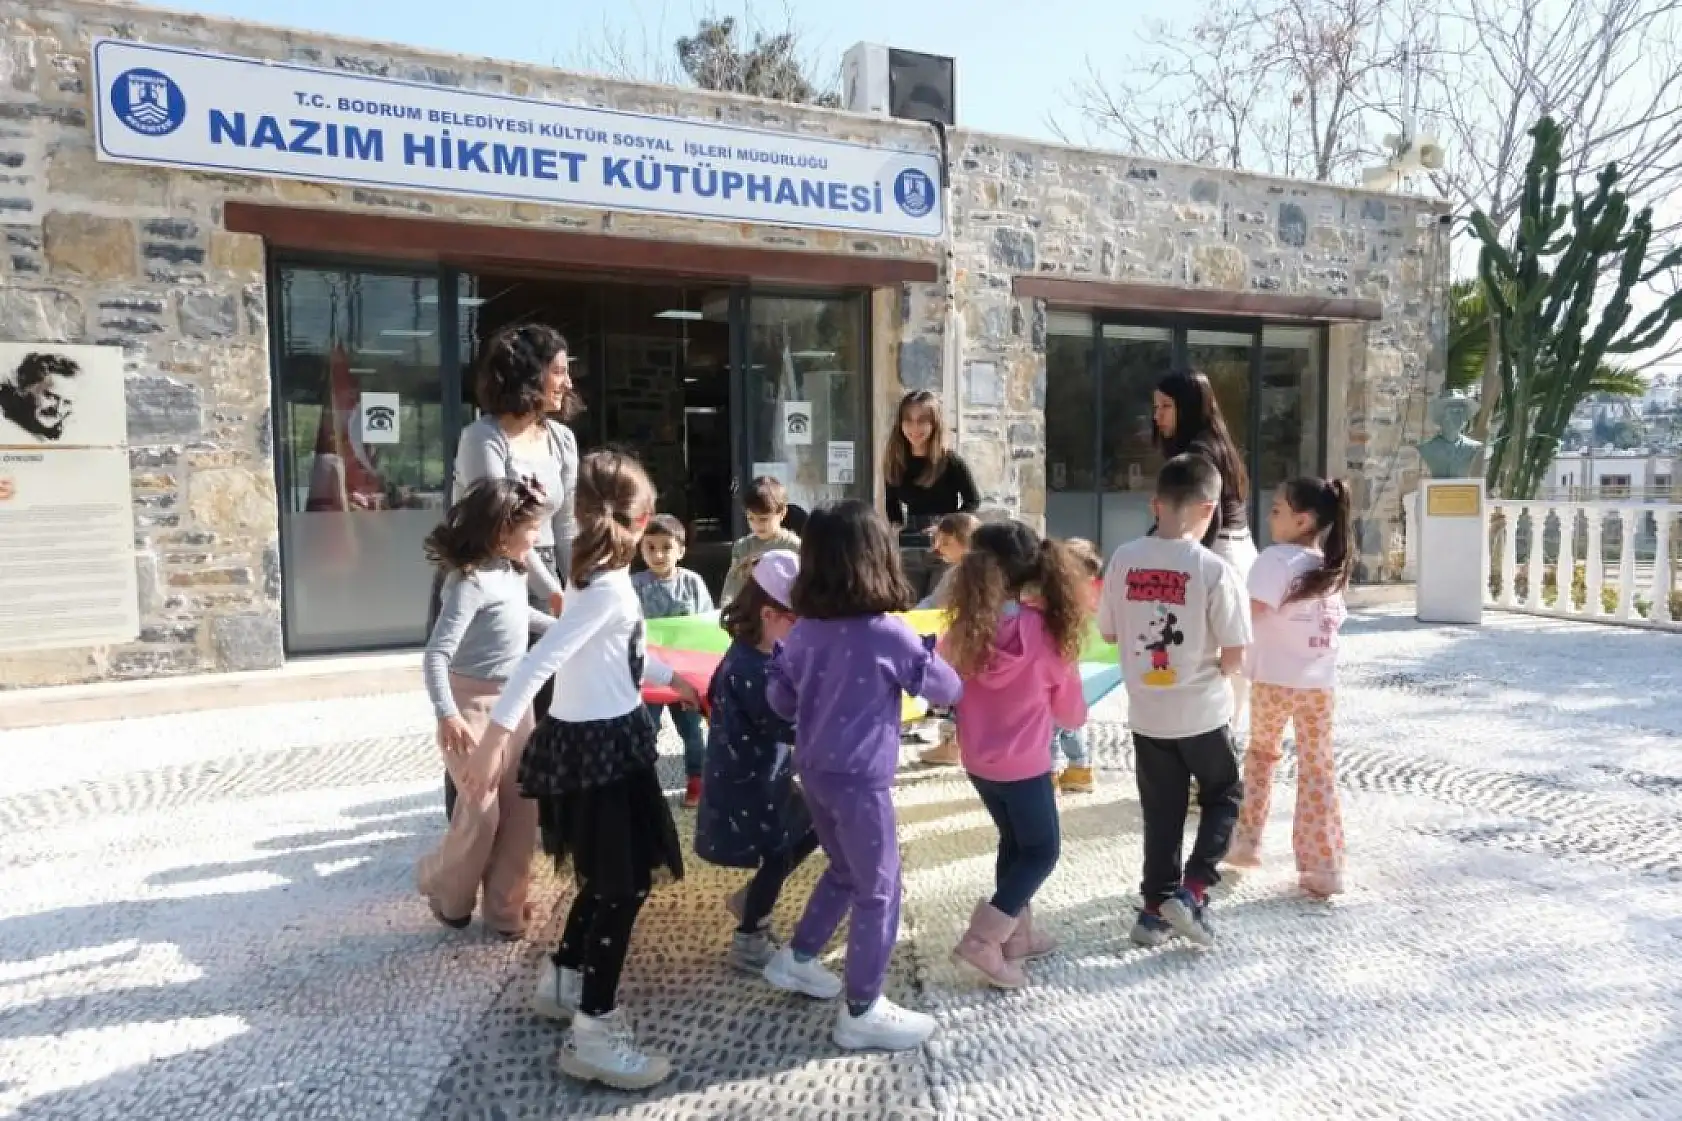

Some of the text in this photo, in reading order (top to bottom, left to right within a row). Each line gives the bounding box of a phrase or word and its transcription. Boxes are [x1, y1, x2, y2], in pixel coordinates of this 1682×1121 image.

[209, 108, 883, 214] NAZIM HİKMET KÜTÜPHANESİ
[294, 91, 331, 109] T.C.
[337, 97, 422, 120] BODRUM
[428, 108, 535, 135] BELEDİYESİ
[540, 121, 608, 144] KÜLTÜR
[612, 132, 675, 152] SOSYAL
[684, 138, 732, 159] İŞLERİ
